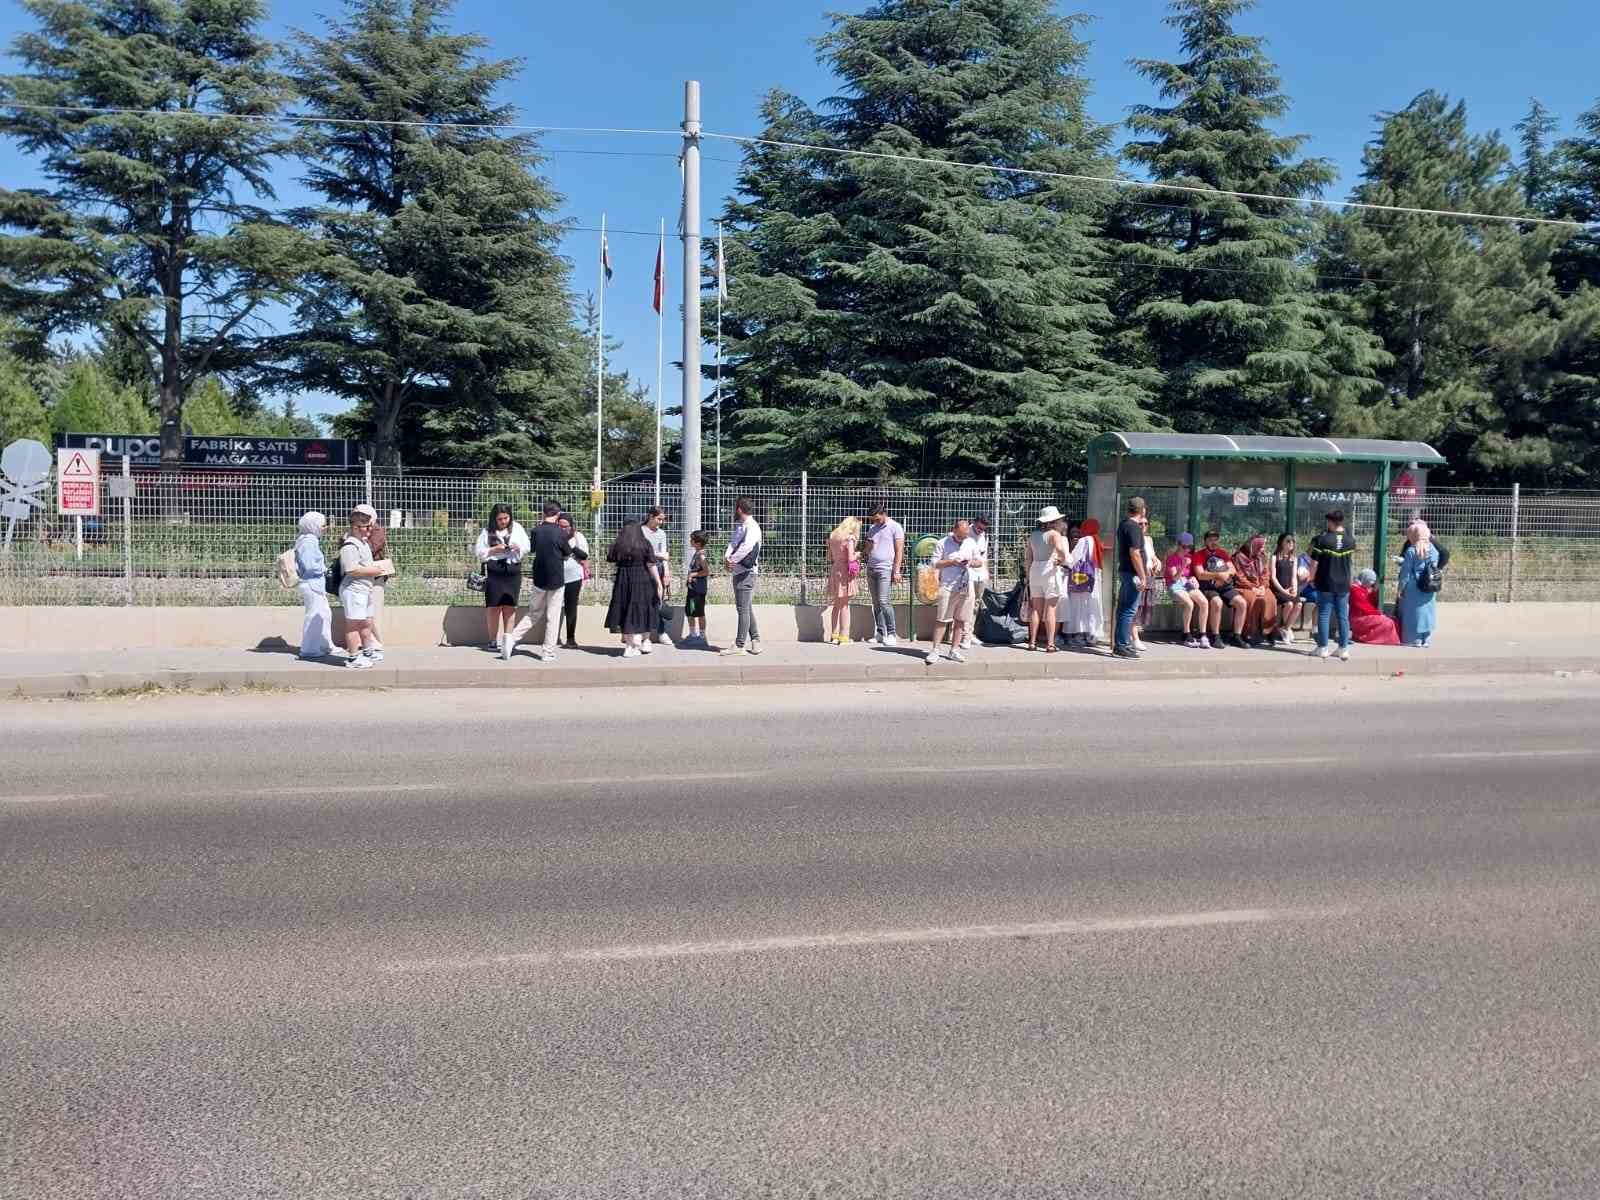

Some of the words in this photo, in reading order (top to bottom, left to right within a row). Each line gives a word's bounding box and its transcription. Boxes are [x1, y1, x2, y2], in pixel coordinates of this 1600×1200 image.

[191, 438, 254, 450] FABRİKA
[257, 441, 298, 454] SATIŞ
[205, 451, 284, 465] MAĞAZASI
